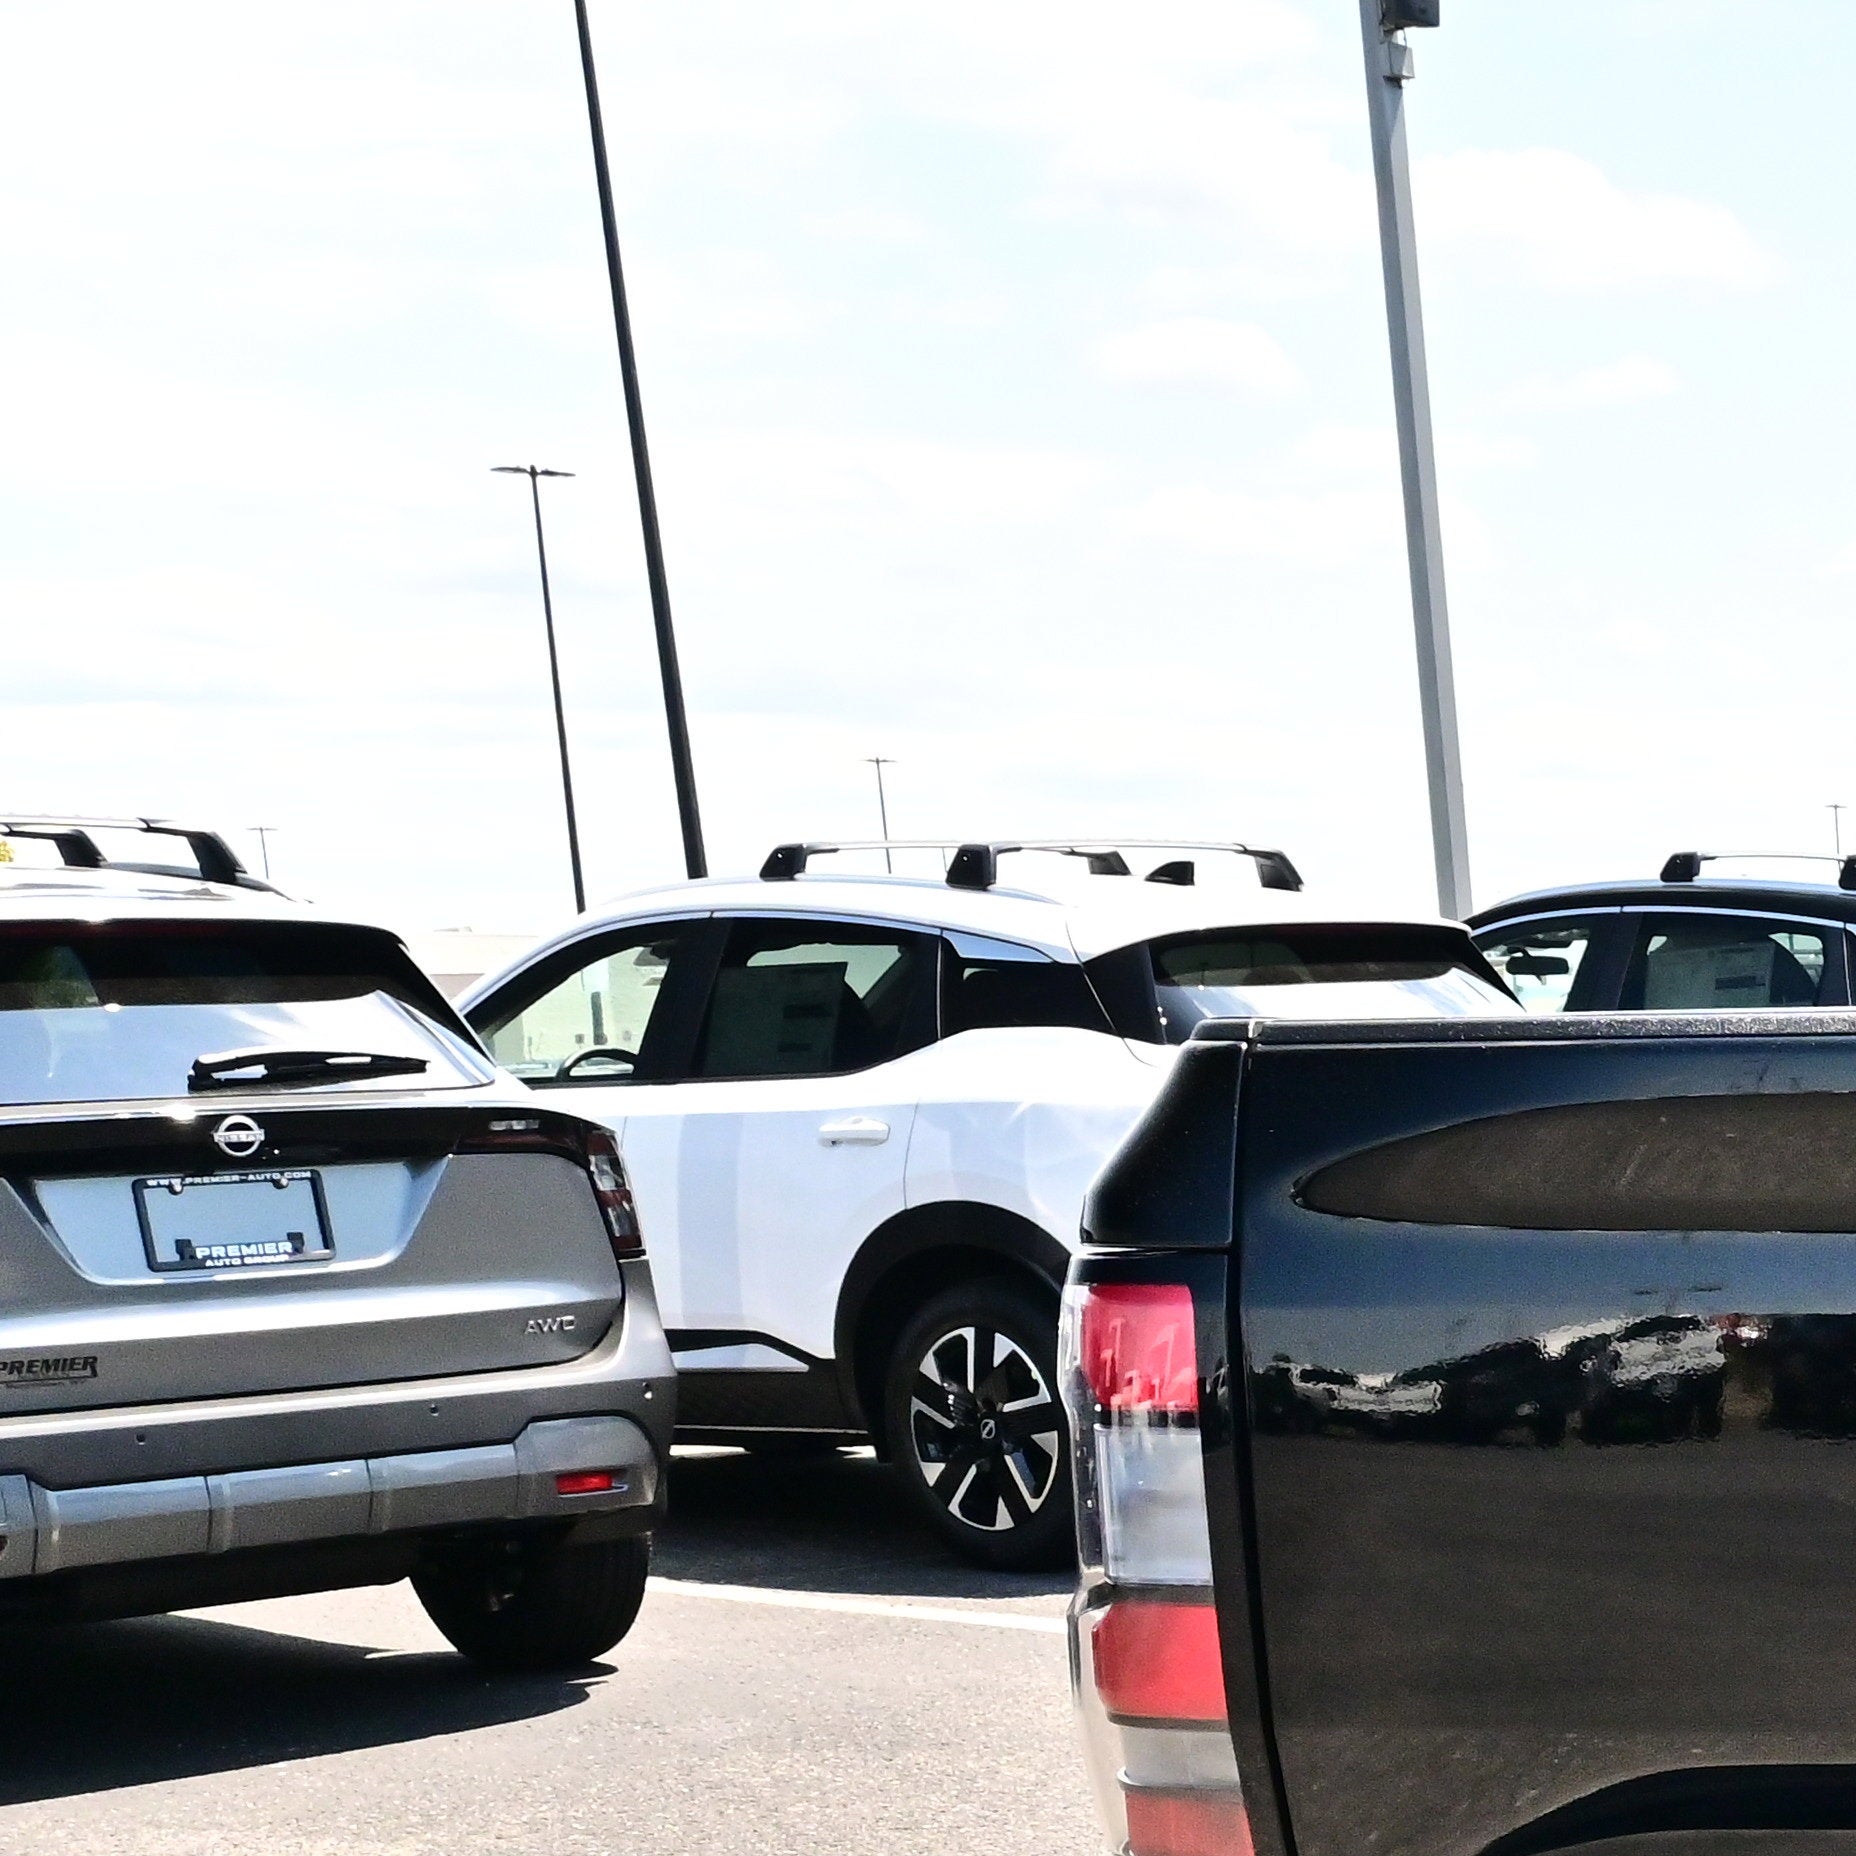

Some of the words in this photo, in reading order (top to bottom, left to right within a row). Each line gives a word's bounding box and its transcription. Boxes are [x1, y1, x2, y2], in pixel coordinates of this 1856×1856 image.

[195, 1241, 293, 1259] PREMIER
[205, 1257, 241, 1267] AUTO
[244, 1254, 289, 1265] GROUP
[525, 1315, 576, 1335] AWD
